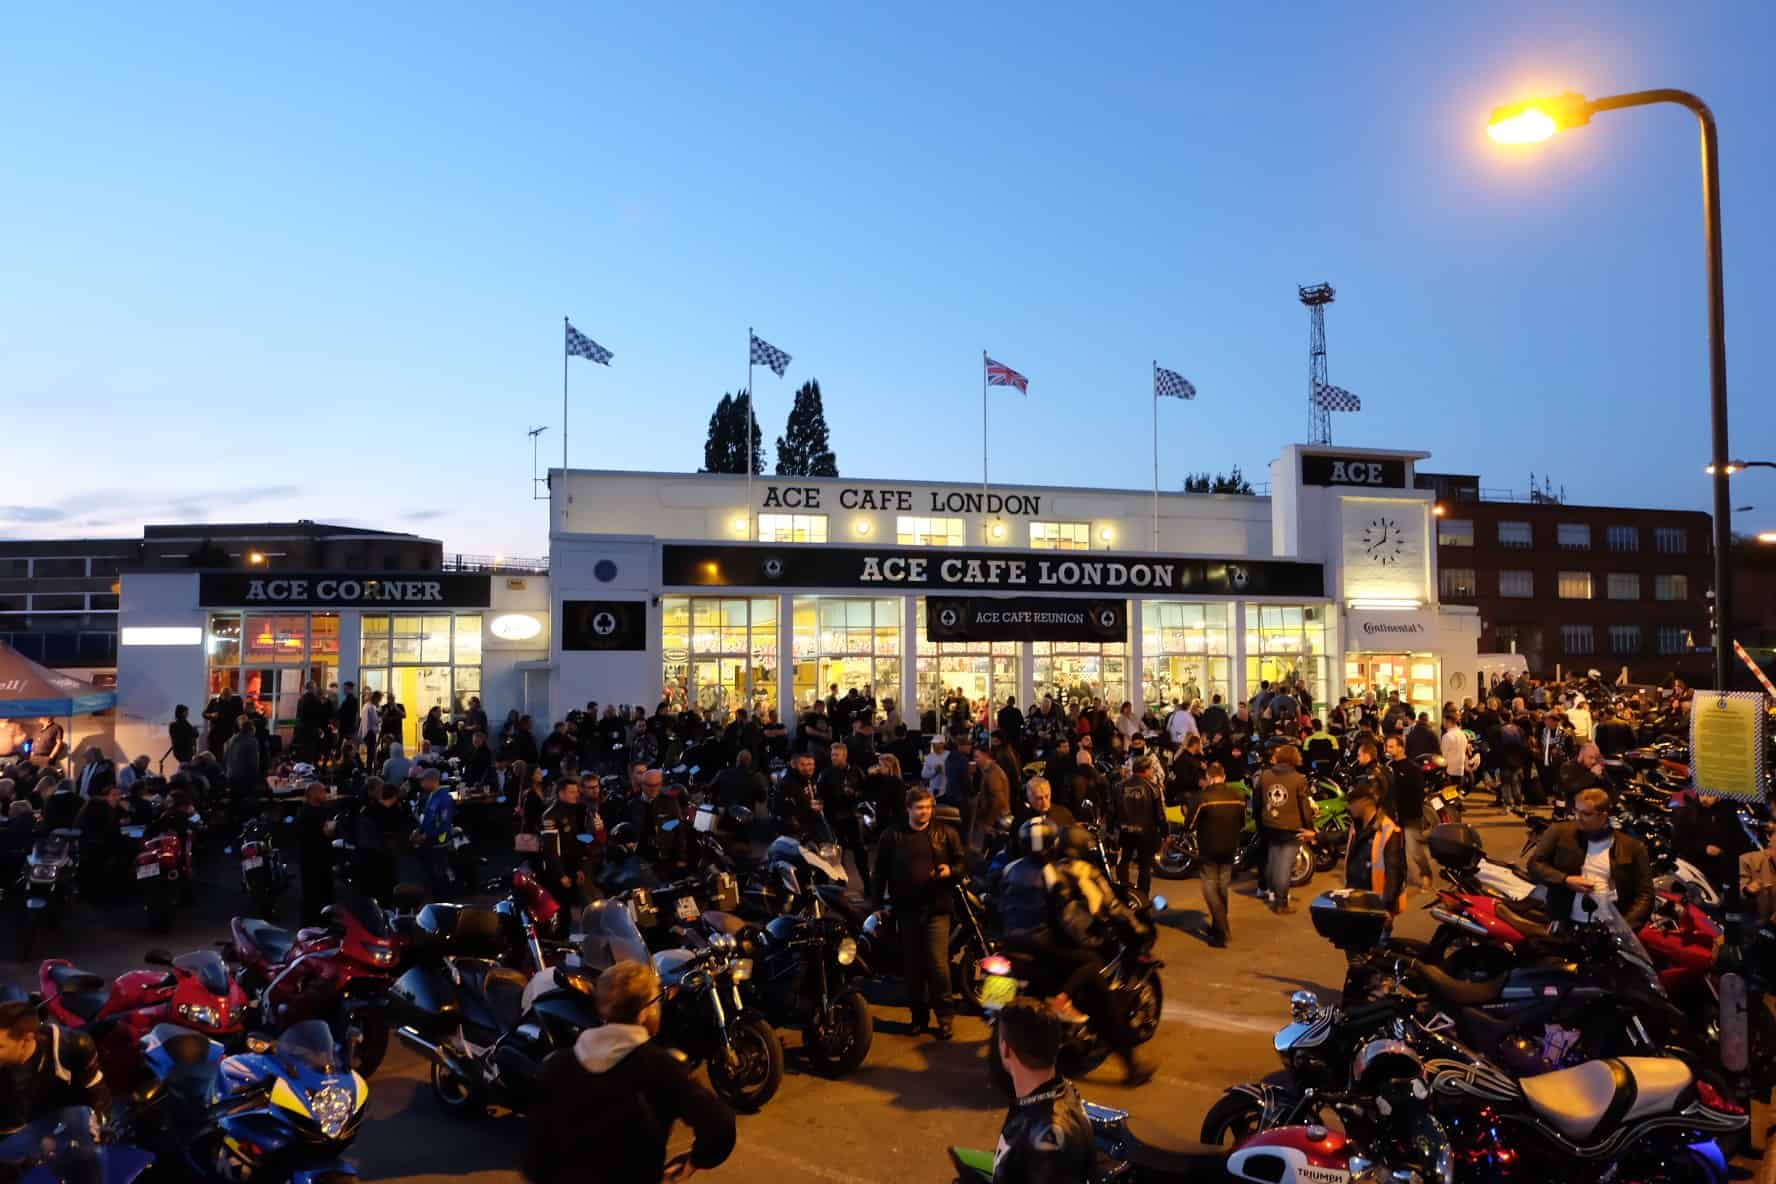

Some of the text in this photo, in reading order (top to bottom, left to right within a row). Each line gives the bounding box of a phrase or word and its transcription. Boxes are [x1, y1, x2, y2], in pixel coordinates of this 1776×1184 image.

[1329, 461, 1383, 483] ACE
[763, 487, 1041, 515] ACE CAFE LONDON
[860, 557, 1174, 587] ACE CAFE LONDON
[246, 580, 442, 600] ACE CORNER
[975, 611, 1084, 624] ACE CAFE REUNION
[1297, 1168, 1343, 1183] TRIUMPH
